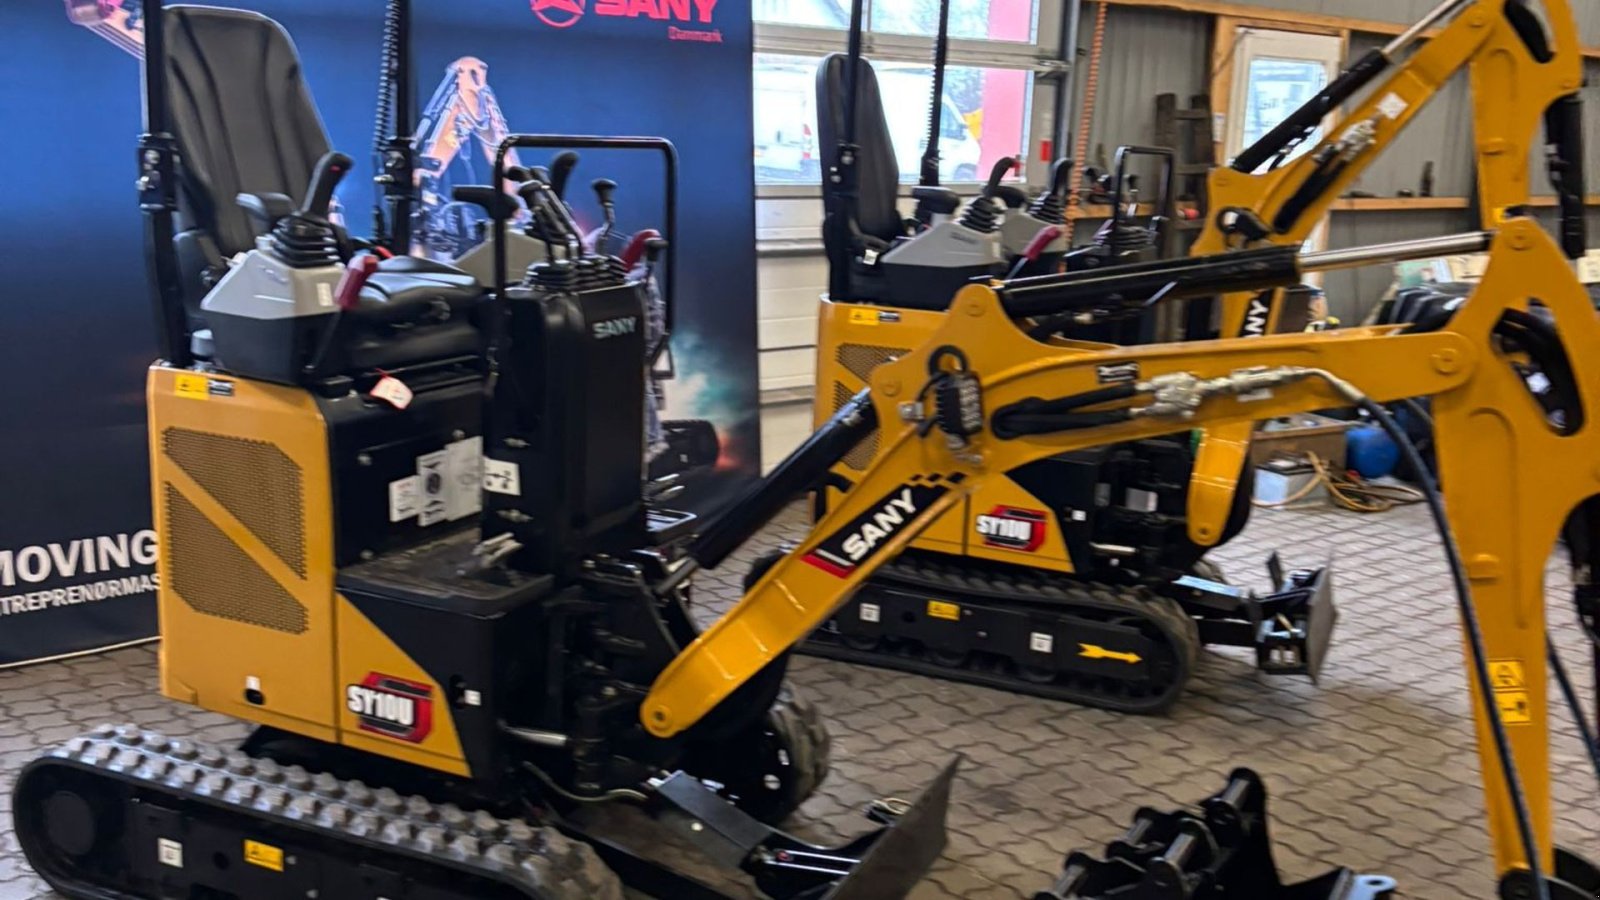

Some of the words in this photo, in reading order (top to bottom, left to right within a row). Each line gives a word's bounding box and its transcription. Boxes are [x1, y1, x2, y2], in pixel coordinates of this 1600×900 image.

[595, 0, 718, 23] SANY
[593, 316, 637, 339] SANY
[1243, 300, 1269, 338] NY
[842, 488, 917, 561] SANY
[976, 515, 1032, 541] SY10U
[347, 685, 414, 726] SY10U
